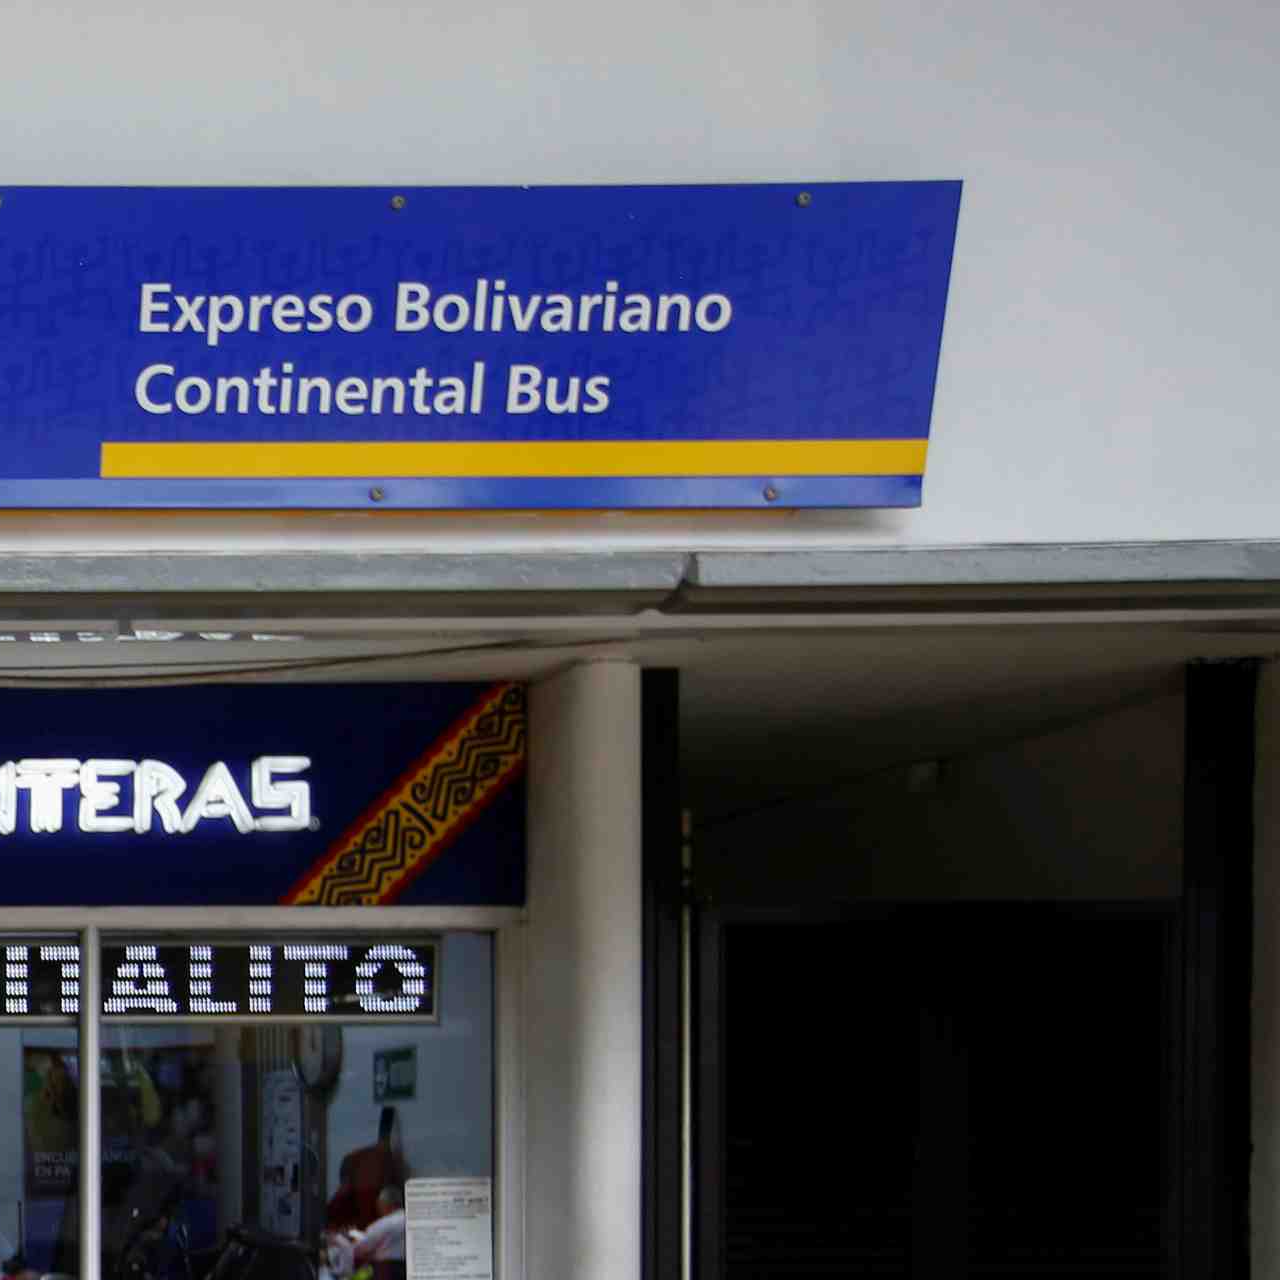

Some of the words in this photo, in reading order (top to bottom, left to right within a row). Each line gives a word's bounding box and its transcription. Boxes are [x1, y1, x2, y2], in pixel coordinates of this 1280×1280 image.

[138, 282, 373, 346] Expreso
[394, 278, 733, 333] Bolivariano
[134, 361, 485, 415] Continental
[506, 364, 610, 414] Bus
